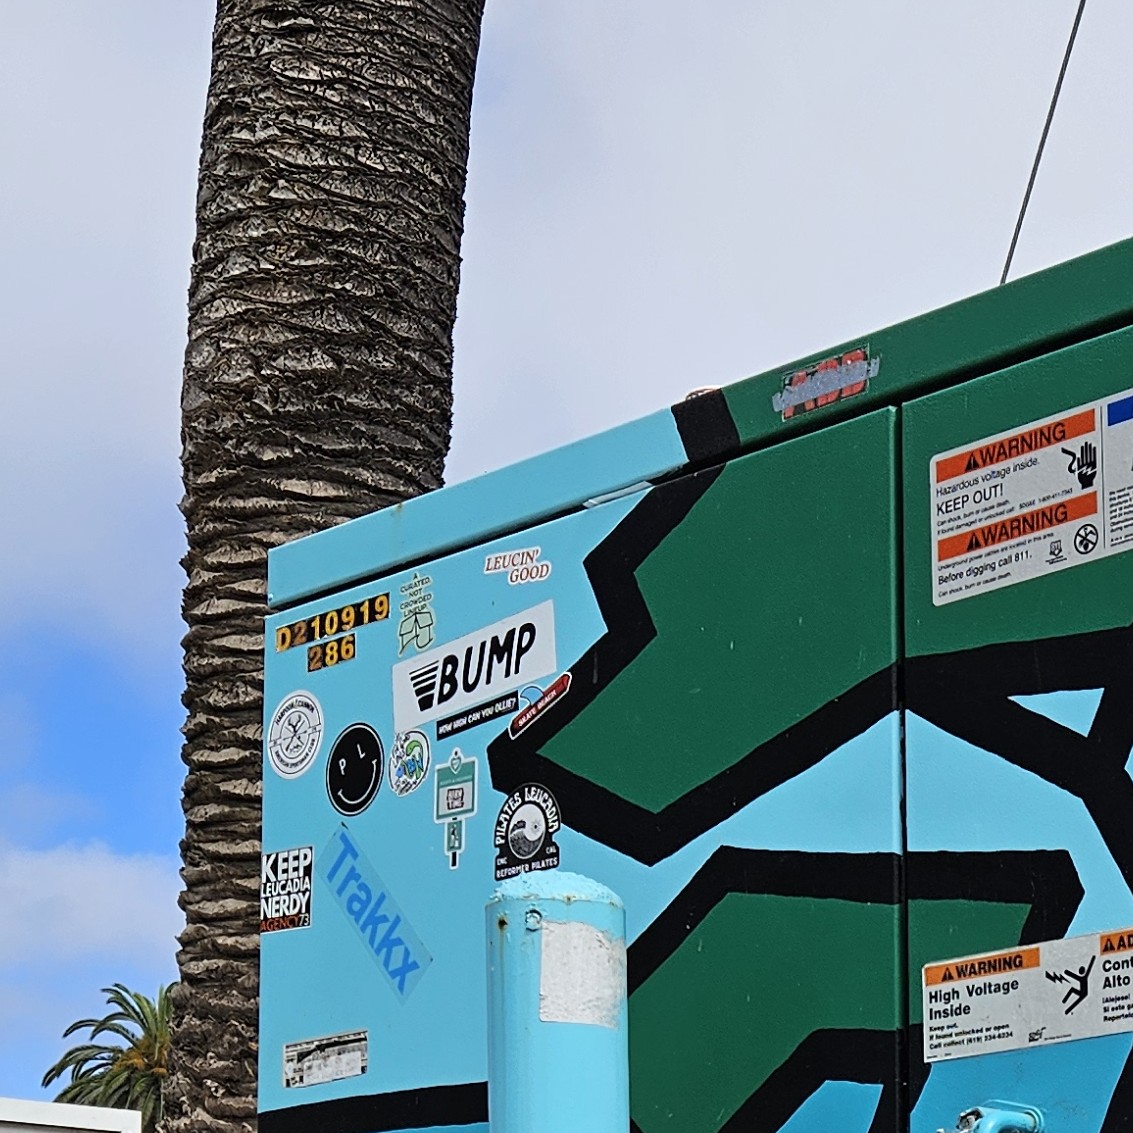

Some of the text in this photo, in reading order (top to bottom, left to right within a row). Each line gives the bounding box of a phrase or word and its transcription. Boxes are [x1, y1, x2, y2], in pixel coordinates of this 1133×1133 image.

[979, 422, 1066, 467] WARNING
[936, 456, 1040, 497] Hazardous voltage inside.
[937, 483, 1003, 516] KEEP OUT!
[981, 503, 1068, 547] WARNING
[485, 549, 539, 572] LEUCIN'
[509, 563, 550, 584] GOOD
[938, 570, 964, 585] Before
[966, 561, 996, 579] digging
[998, 554, 1012, 568] call
[1014, 550, 1032, 562] 811.
[276, 596, 389, 651] D210919
[308, 636, 355, 671] 286
[437, 622, 536, 705] BUMP
[496, 792, 522, 845] PILATES
[524, 787, 559, 832] LEUCADIA
[261, 848, 312, 884] KEEP
[261, 876, 311, 897] LEUCADIA
[260, 891, 310, 921] NERDY
[326, 833, 421, 995] Trakkx
[956, 954, 1023, 979] WARNING
[1102, 971, 1131, 989] Alto
[928, 978, 1019, 1005] High Voltage
[928, 1003, 971, 1021] Inside
